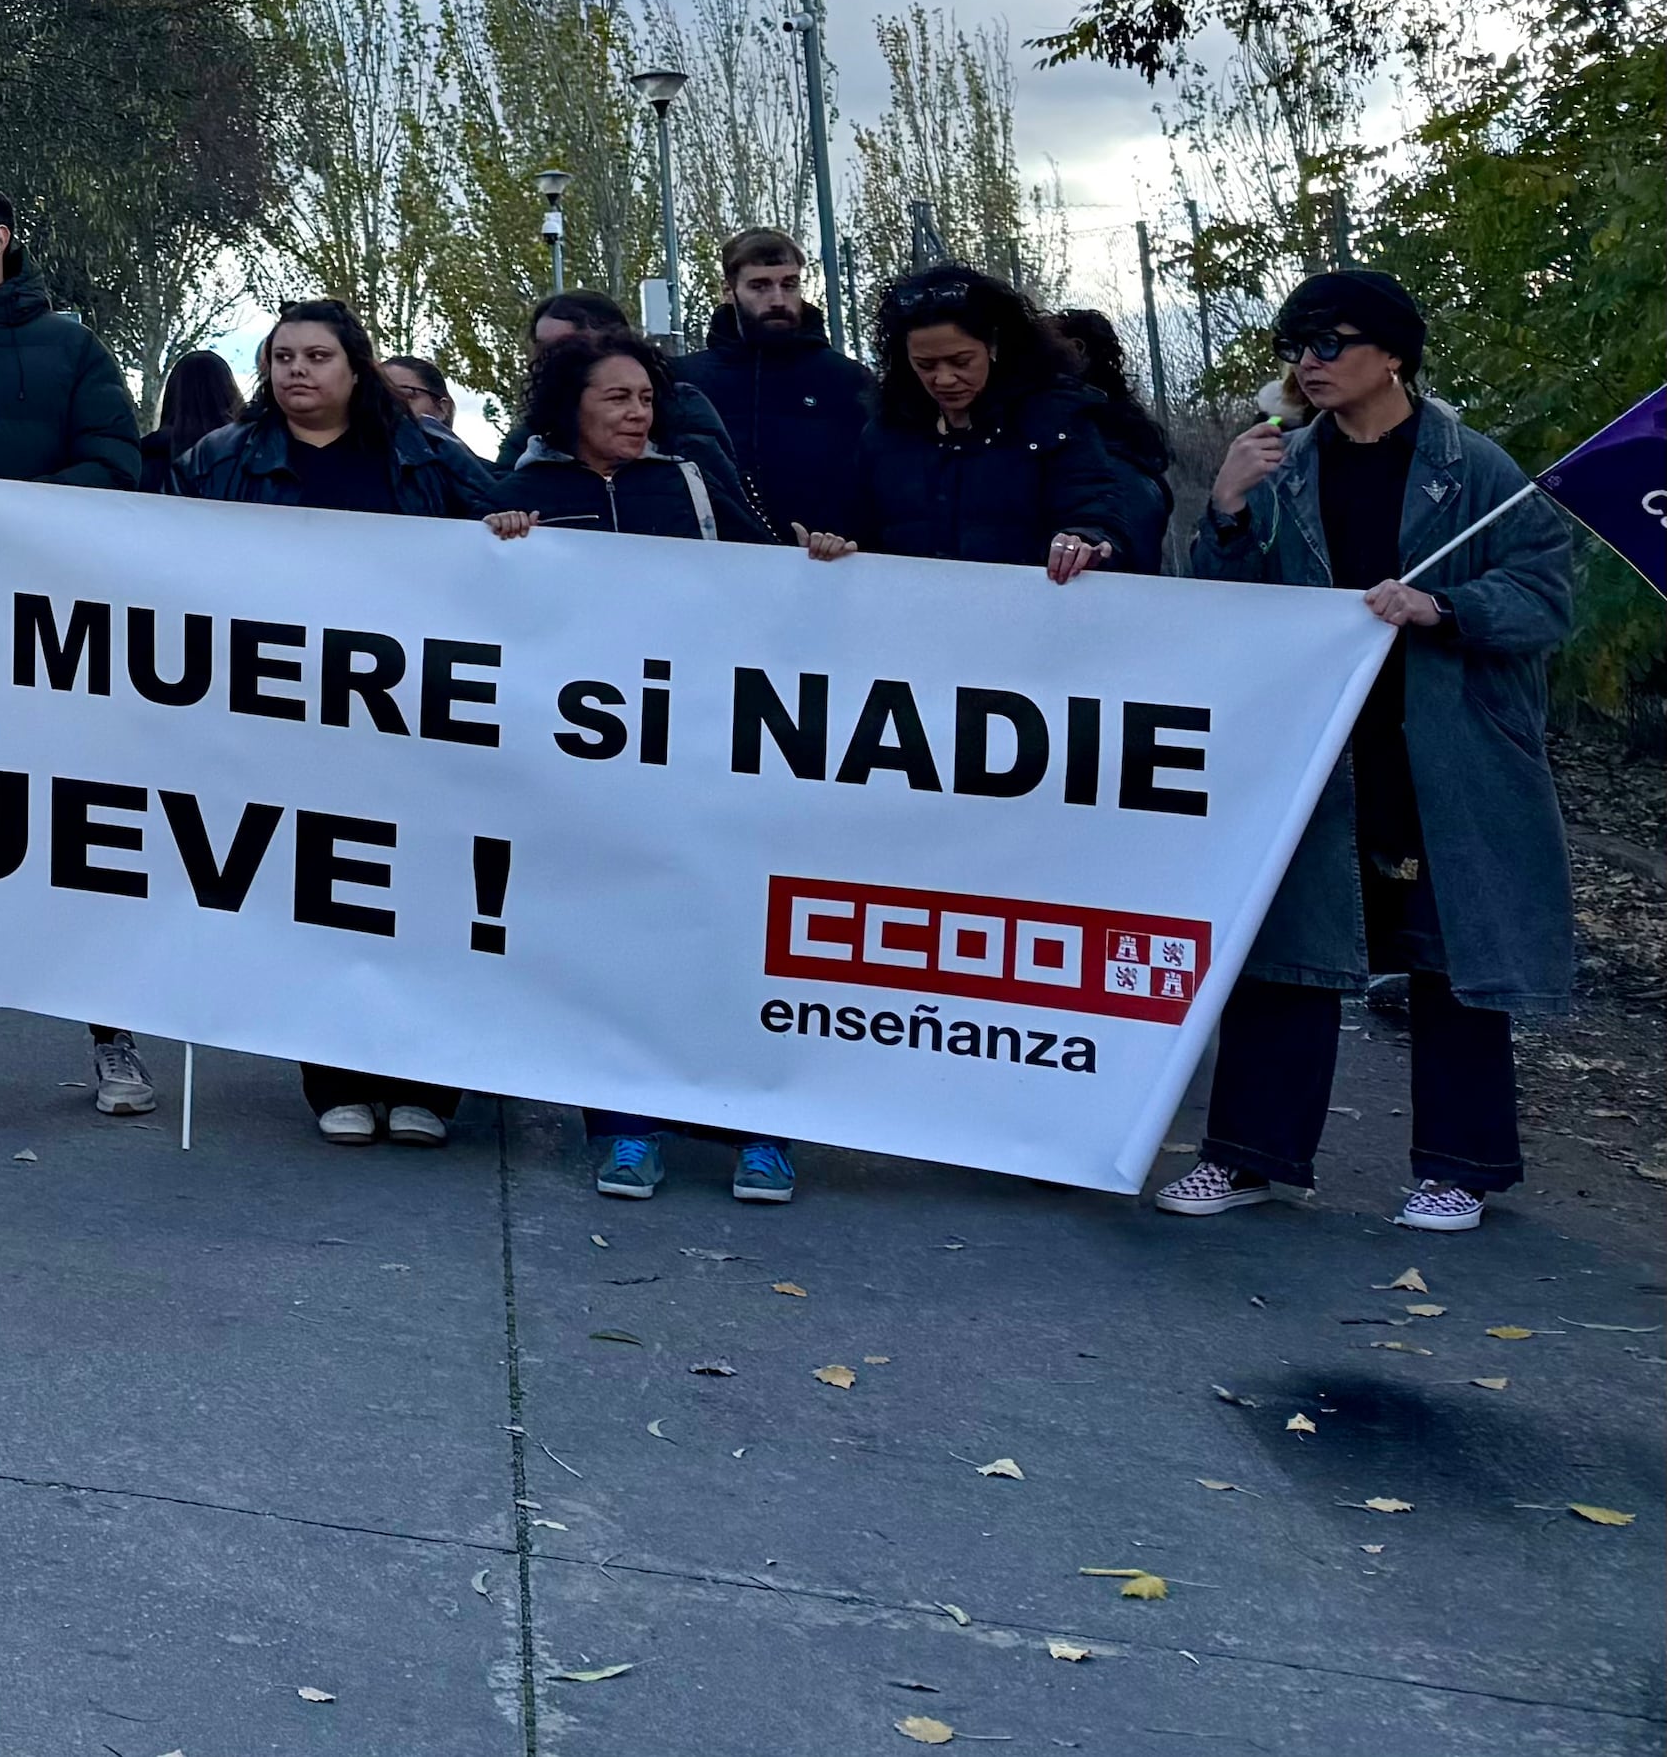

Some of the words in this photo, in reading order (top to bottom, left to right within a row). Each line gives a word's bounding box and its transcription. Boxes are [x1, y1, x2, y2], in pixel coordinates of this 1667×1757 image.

[11, 590, 503, 749] MUERE
[551, 657, 672, 767] si
[729, 665, 1212, 819] NADIE
[469, 835, 513, 957] !
[788, 894, 1086, 991] CCOO
[759, 998, 1098, 1075] enseñanza
